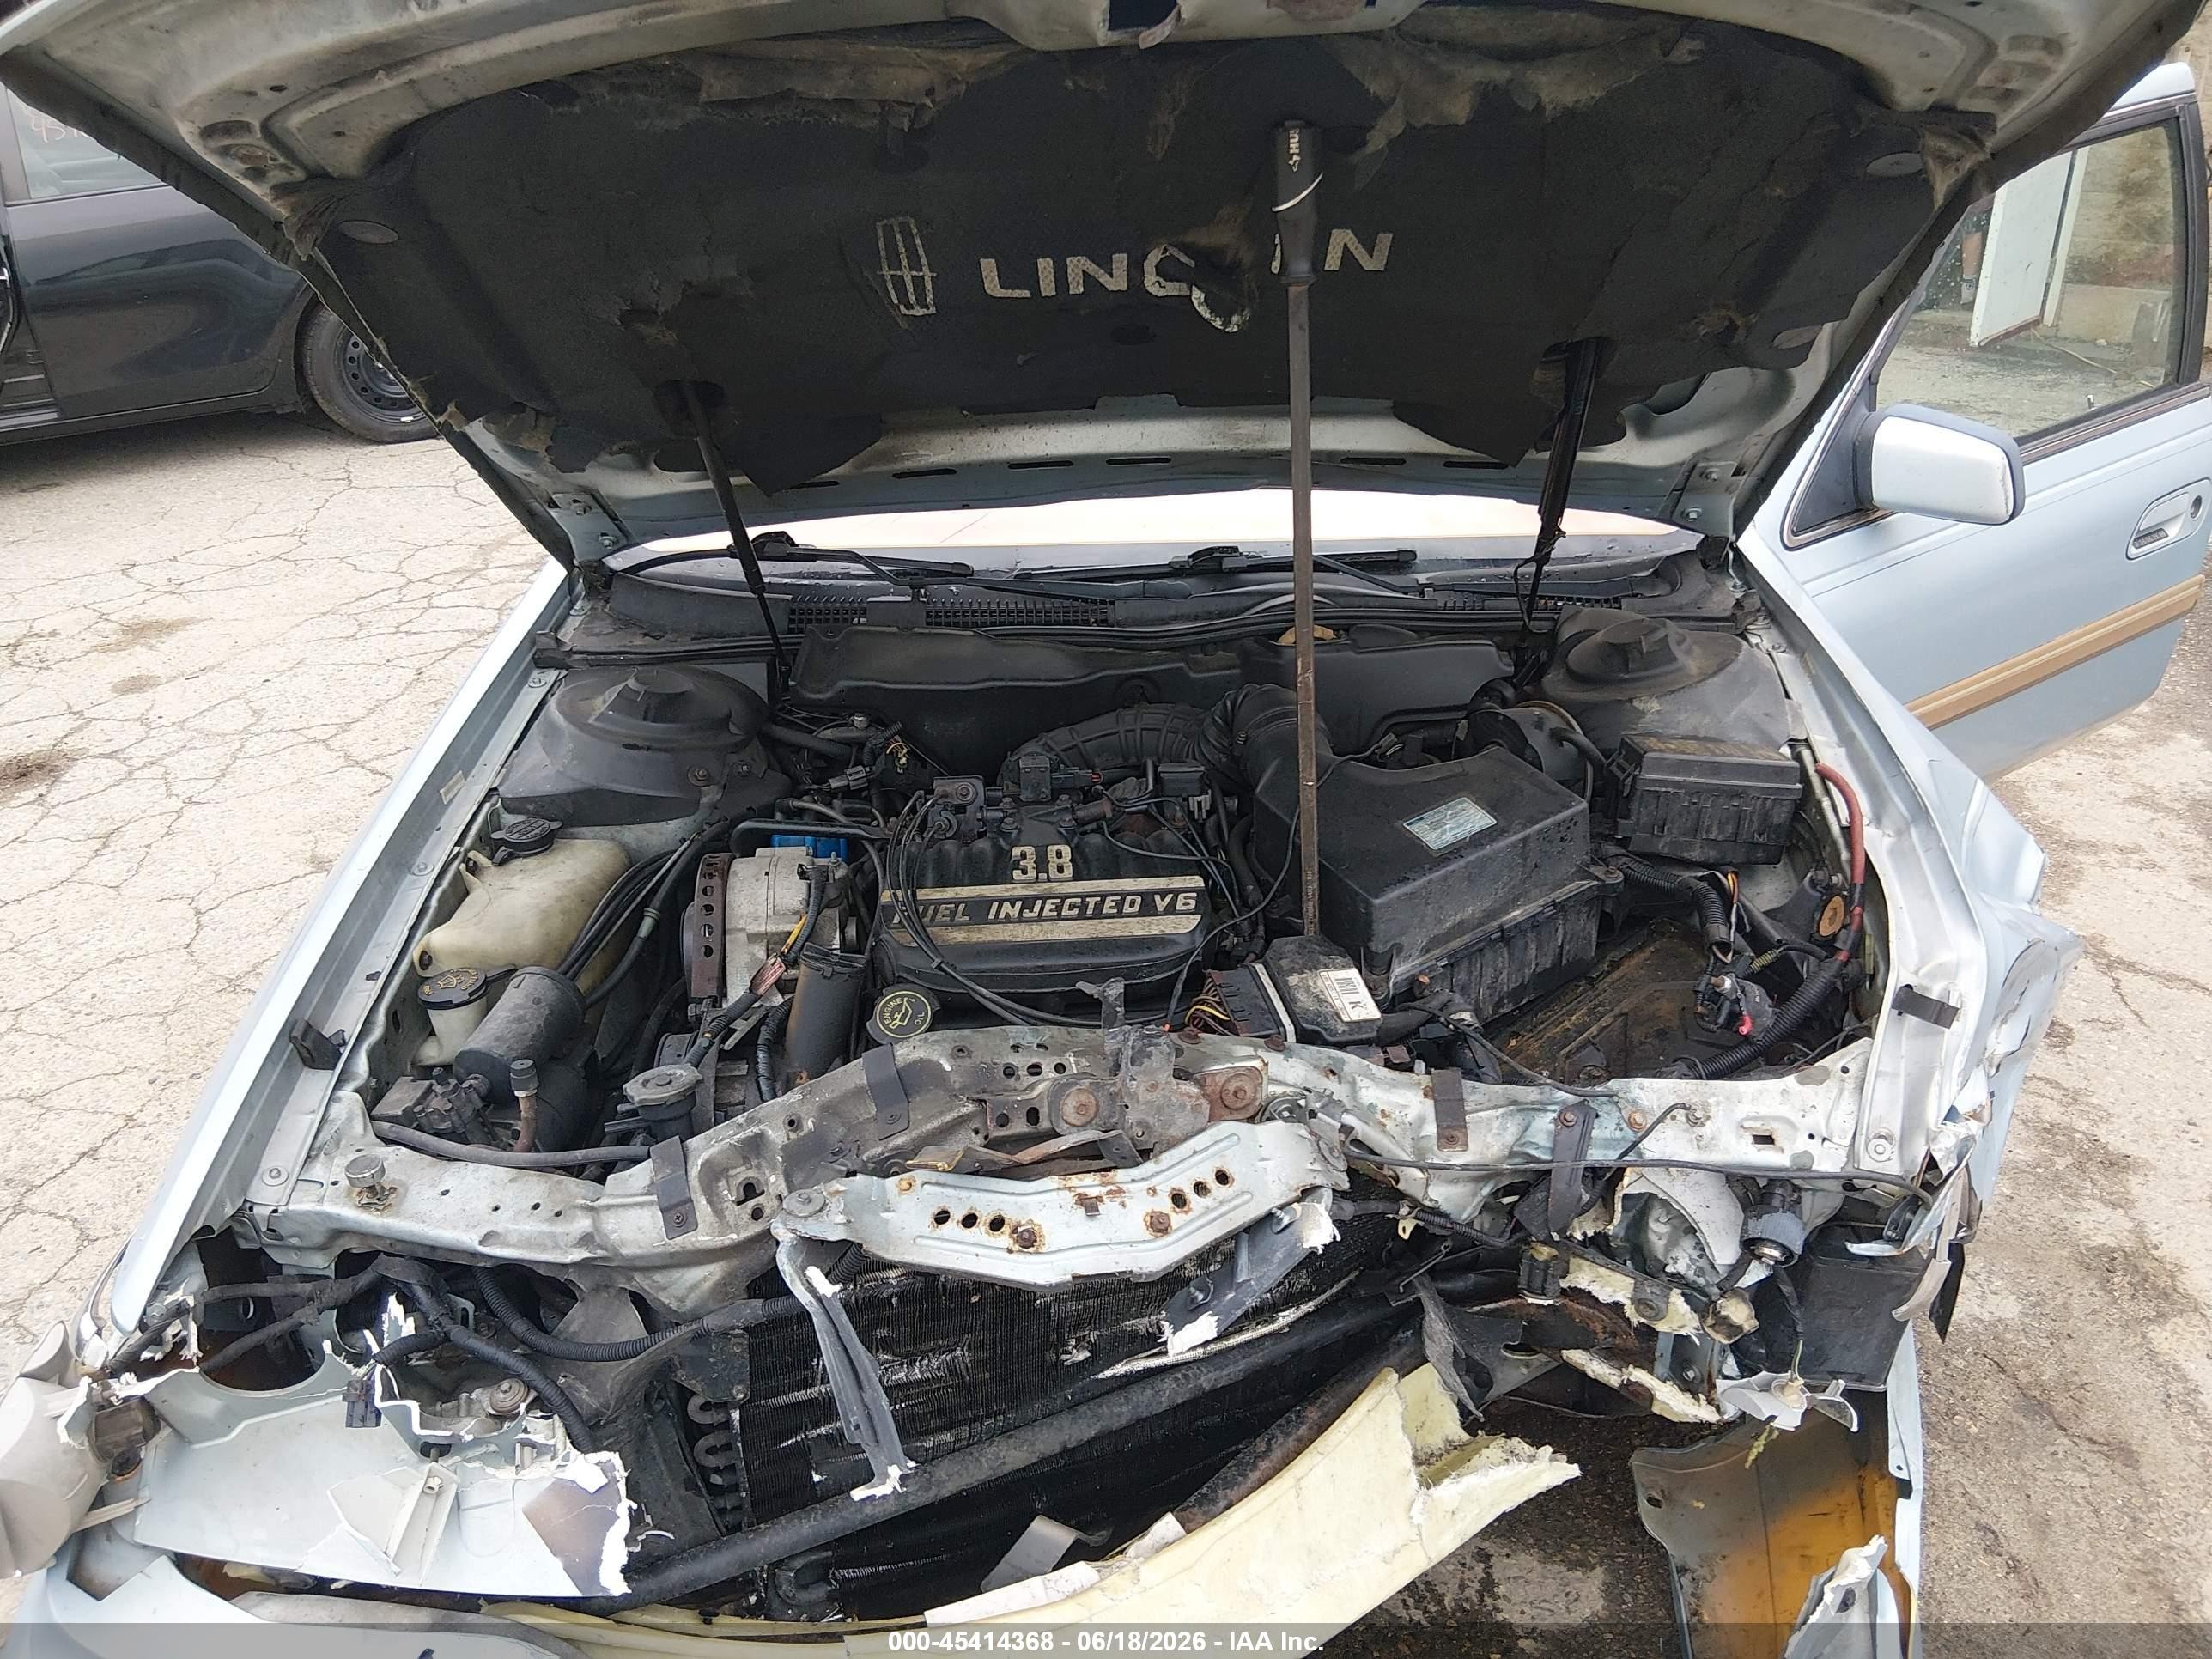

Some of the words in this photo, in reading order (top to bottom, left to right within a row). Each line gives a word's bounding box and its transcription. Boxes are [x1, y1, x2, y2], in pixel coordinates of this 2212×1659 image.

[1010, 843, 1073, 881] 3.8
[988, 895, 1143, 921] INJECTED
[1153, 891, 1198, 913] V6
[883, 997, 903, 1024] ENGINE
[914, 1012, 926, 1026] OIL
